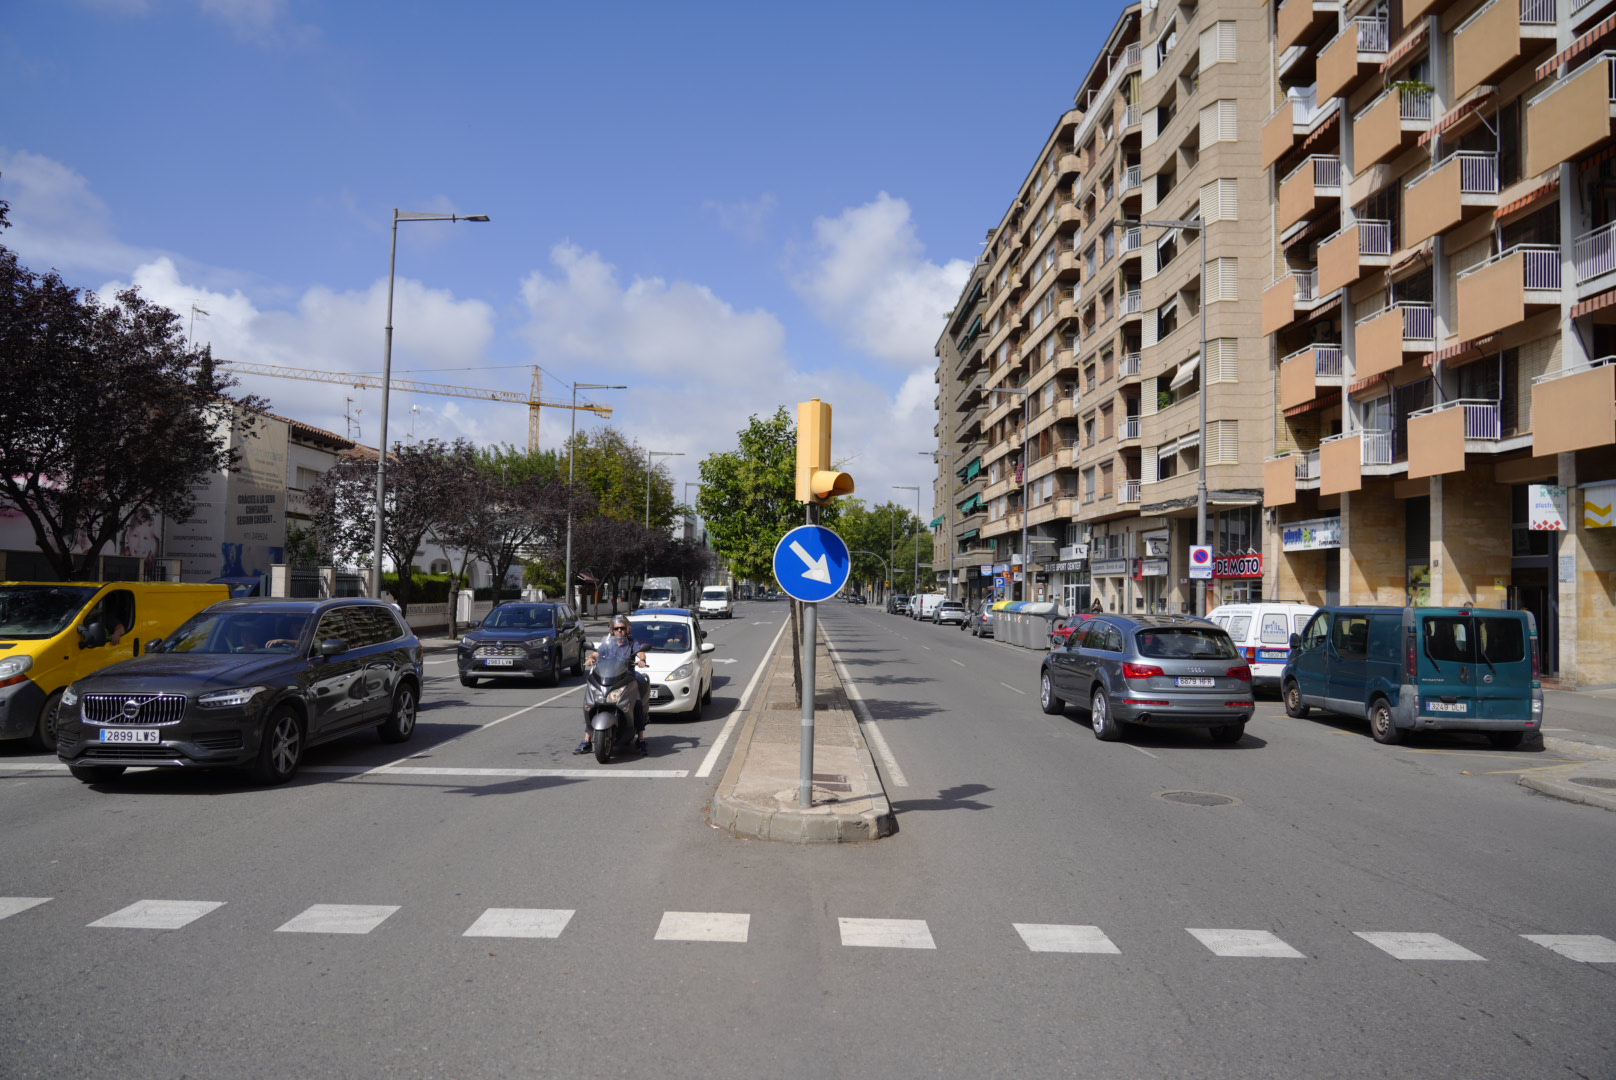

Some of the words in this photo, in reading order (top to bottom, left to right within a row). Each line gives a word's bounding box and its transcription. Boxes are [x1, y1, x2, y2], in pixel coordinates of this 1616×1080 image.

[1055, 562, 1067, 571] SPORT
[1067, 561, 1081, 570] CENTER
[1216, 559, 1228, 575] DE
[1229, 556, 1260, 575] MOTO
[995, 578, 1004, 588] P
[1431, 703, 1449, 711] 3249
[107, 731, 133, 742] 2899
[136, 731, 157, 742] LWS
